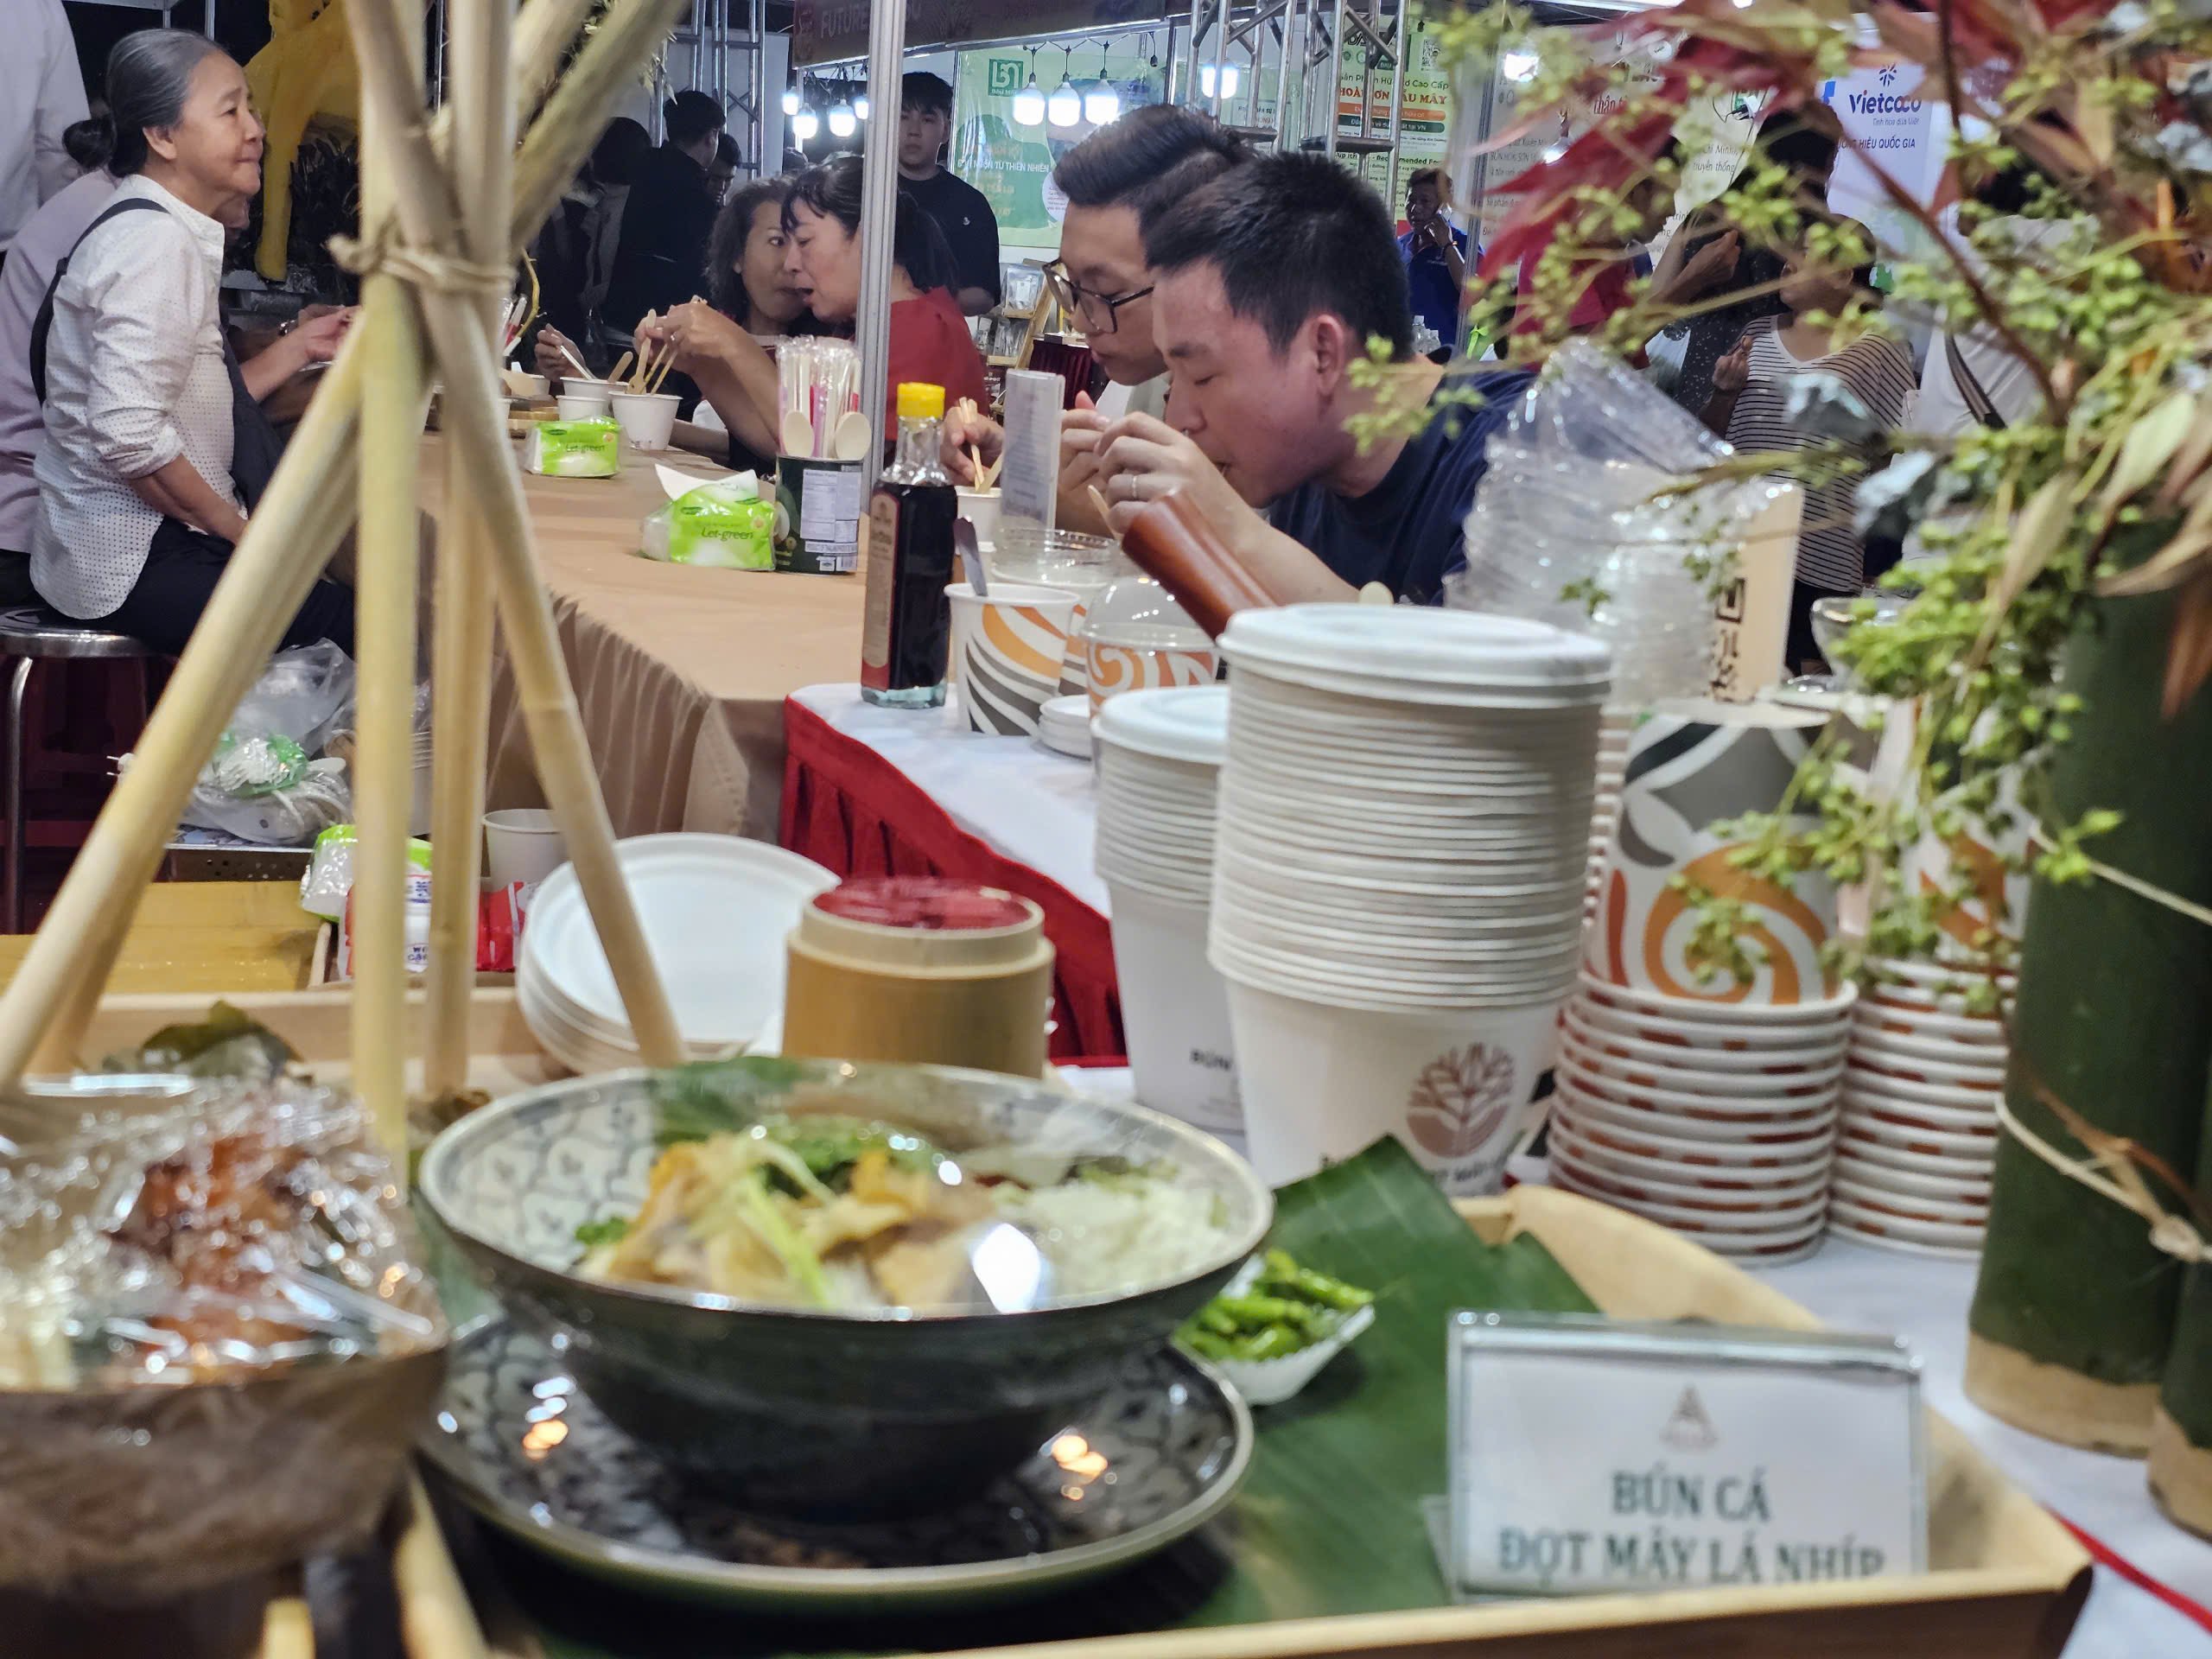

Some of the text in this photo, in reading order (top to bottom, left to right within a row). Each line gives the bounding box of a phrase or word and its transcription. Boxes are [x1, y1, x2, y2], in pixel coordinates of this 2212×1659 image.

[1849, 90, 1923, 115] Vietcoco
[1903, 138, 1916, 149] GIA
[701, 527, 754, 541] Let-green
[1612, 1461, 1770, 1522] BÚN CÁ
[1498, 1529, 1588, 1587] ĐỌT
[1710, 1529, 1762, 1582] LÁ
[1775, 1534, 1885, 1582] NHÍP
